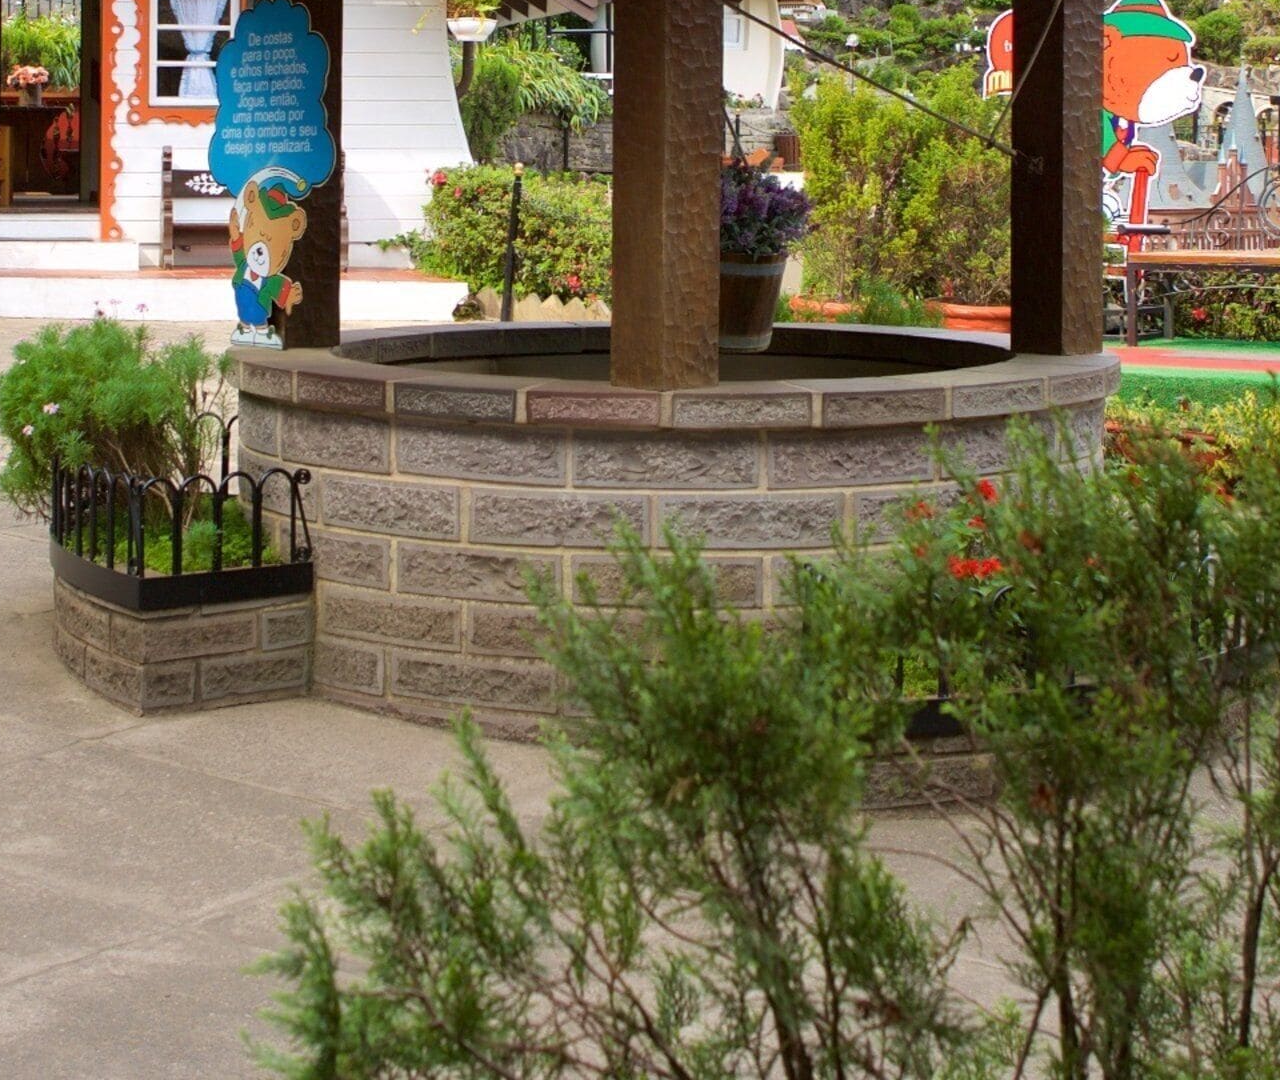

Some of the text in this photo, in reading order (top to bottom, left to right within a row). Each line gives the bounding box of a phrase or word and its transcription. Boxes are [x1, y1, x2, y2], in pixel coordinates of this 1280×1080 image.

[249, 32, 293, 46] De costas
[242, 51, 262, 65] para
[264, 51, 271, 60] o
[230, 61, 309, 78] e olhos fechados,
[233, 77, 305, 96] faça um pedido.
[986, 69, 1012, 96] MI
[232, 110, 305, 124] uma moeda por
[221, 124, 318, 139] cima do ombro e seu
[224, 141, 253, 157] desejo
[255, 143, 266, 153] se
